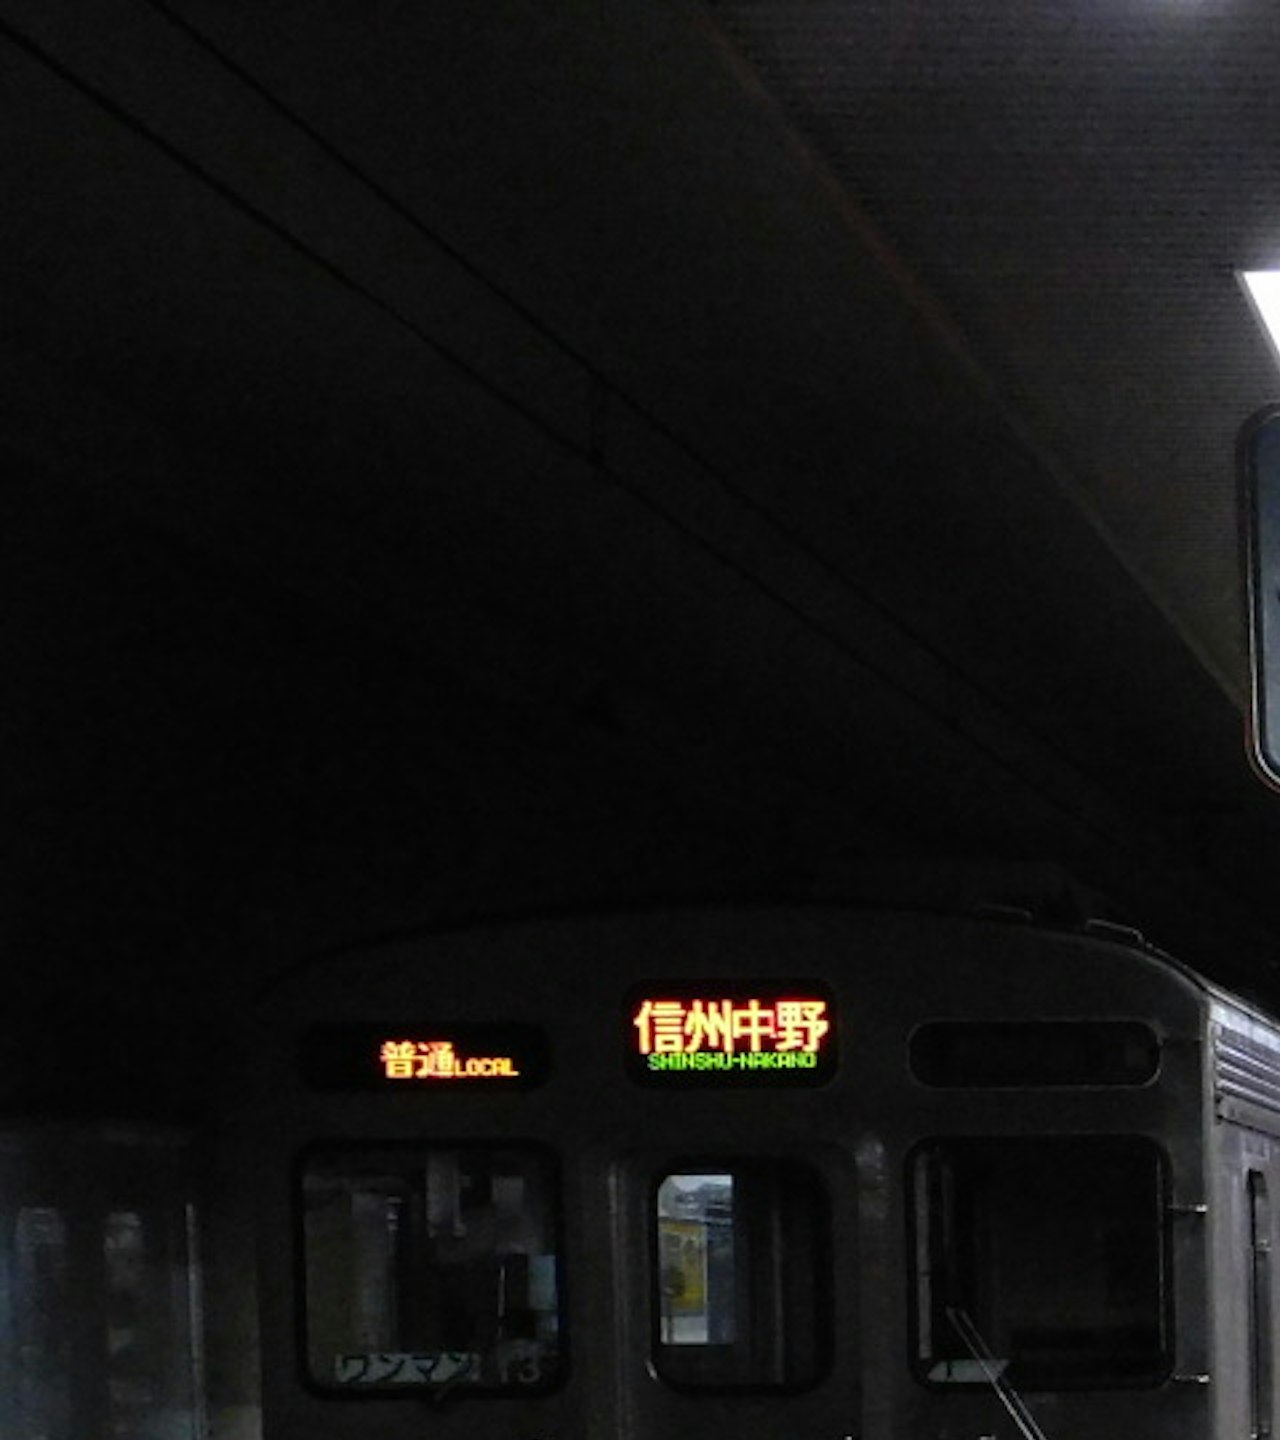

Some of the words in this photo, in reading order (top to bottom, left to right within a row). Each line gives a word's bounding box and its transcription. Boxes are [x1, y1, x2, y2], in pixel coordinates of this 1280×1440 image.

[634, 999, 829, 1054] 信州中野
[380, 1040, 455, 1078] 普通
[455, 1057, 519, 1077] LOCAL
[648, 1052, 817, 1070] SHINSHU-NAKANO
